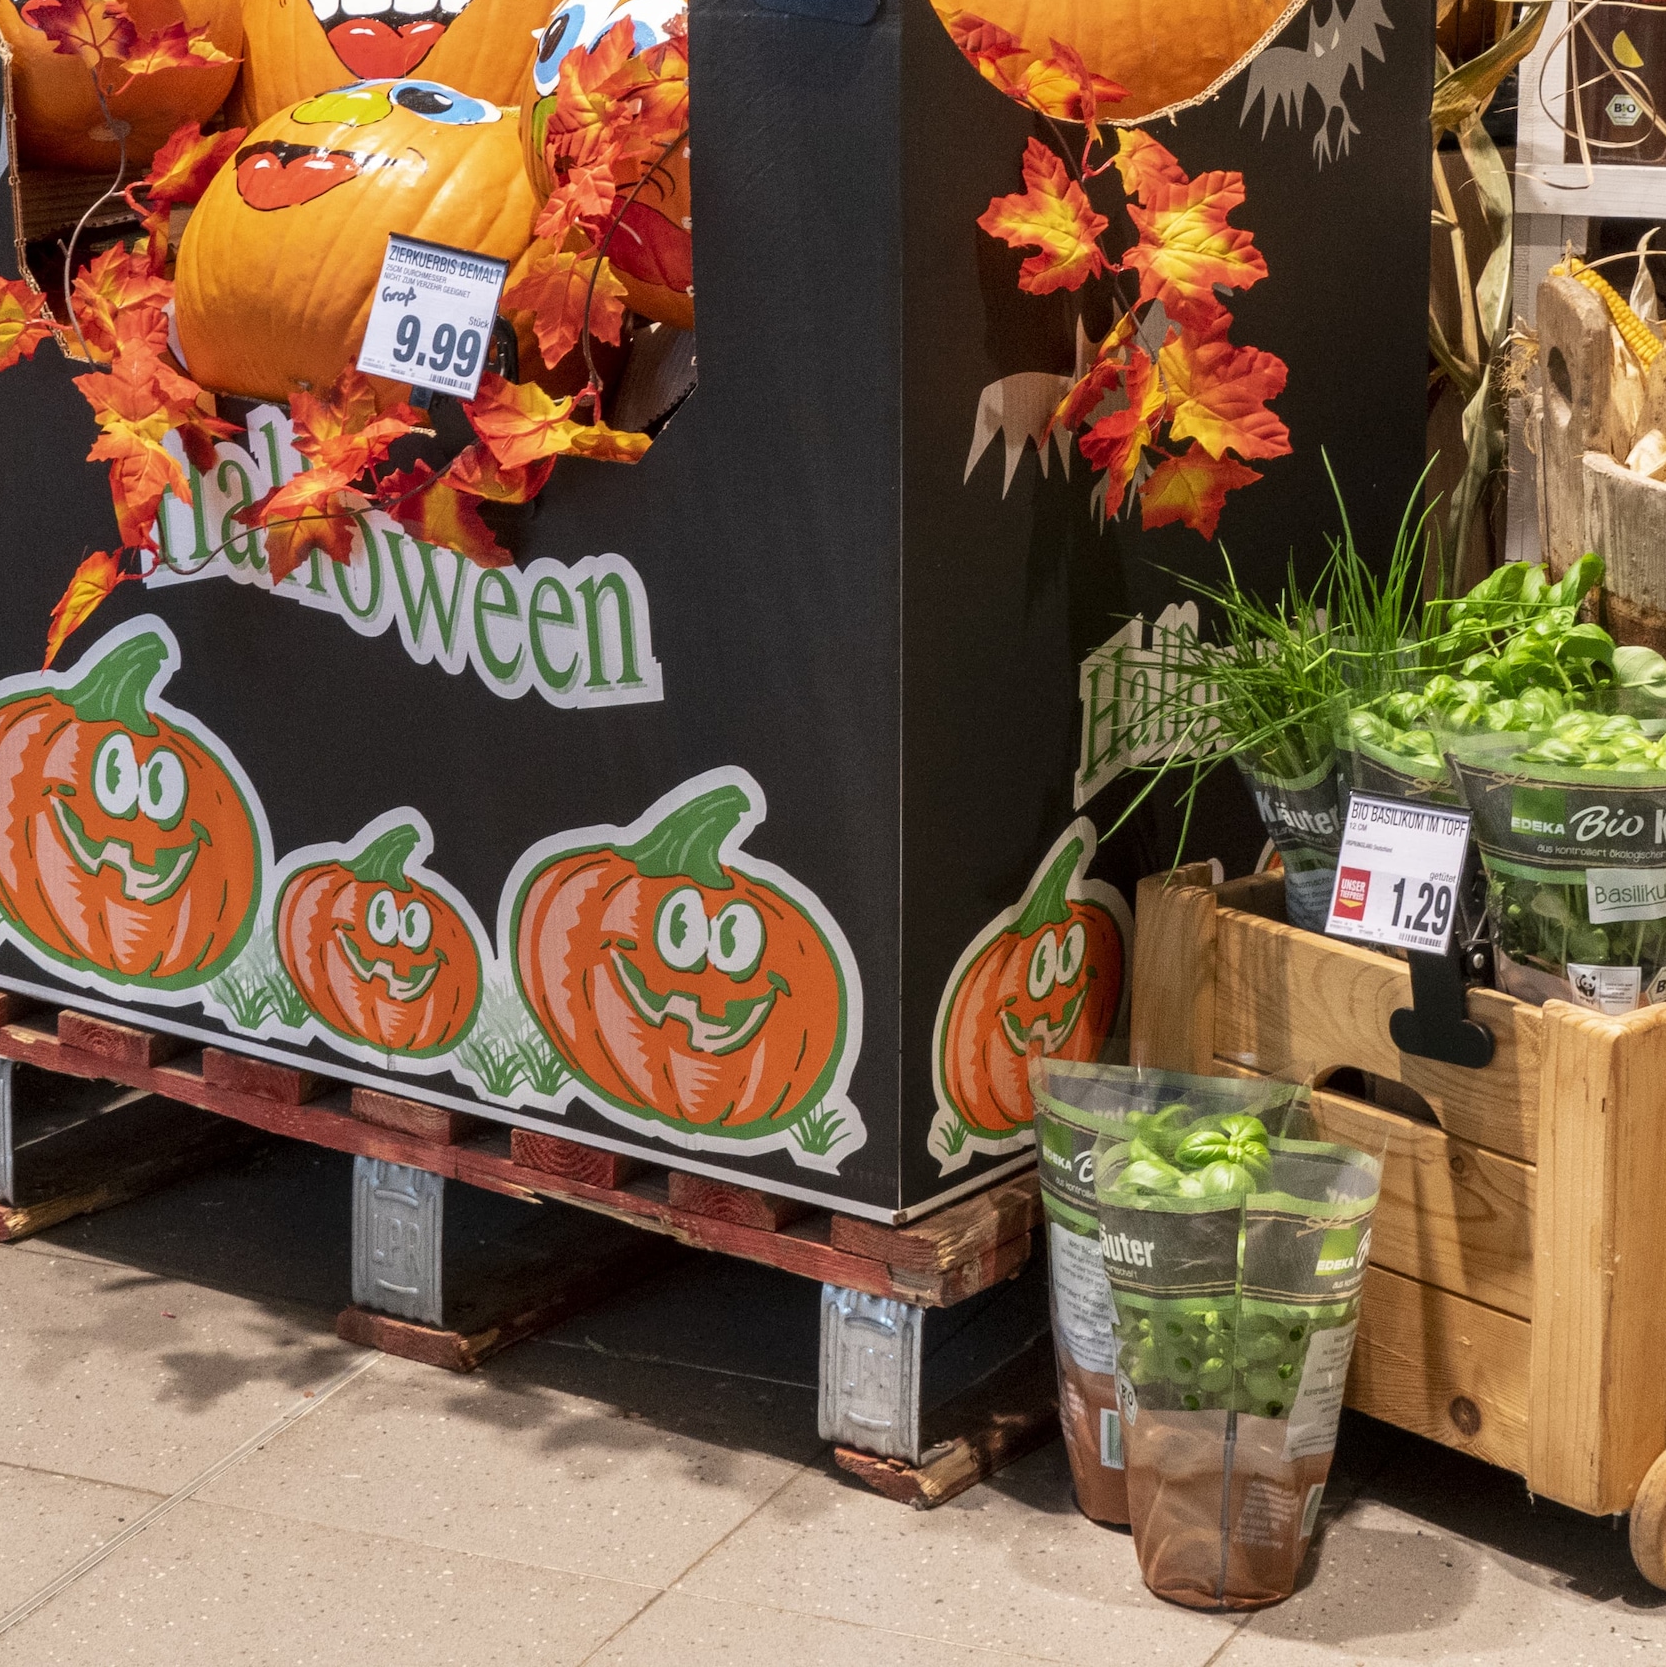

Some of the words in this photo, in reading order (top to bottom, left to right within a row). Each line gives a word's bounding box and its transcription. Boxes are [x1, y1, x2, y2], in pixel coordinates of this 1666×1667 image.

[385, 263, 404, 273] 25CM
[403, 267, 448, 285] DURCHMESSER
[388, 244, 459, 276] ZIERKUERBIS
[458, 261, 503, 286] BEMALT
[382, 285, 418, 308] Groß
[383, 272, 402, 283] NICHT
[402, 276, 417, 286] ZUM
[416, 278, 443, 294] VERZEHR
[442, 285, 472, 300] GEEIGNET
[468, 316, 491, 330] Stück
[393, 314, 482, 379] 9.99
[1351, 801, 1369, 822] BIO
[1370, 805, 1428, 831] BASILIKUM
[1426, 815, 1441, 833] IM
[1441, 818, 1468, 839] TOPF
[1510, 816, 1566, 835] EDEKA
[1569, 804, 1645, 842] Bio
[1536, 843, 1554, 853] aus
[1555, 843, 1607, 859] kontrolliert
[1609, 847, 1666, 865] ökologischer
[1340, 878, 1367, 893] UNSER
[1429, 870, 1458, 884] getütet
[1339, 888, 1365, 902] TIEFPREIS
[1390, 876, 1453, 937] 1.29
[1100, 1223, 1155, 1268] äuter
[1315, 1256, 1355, 1272] EDEKA
